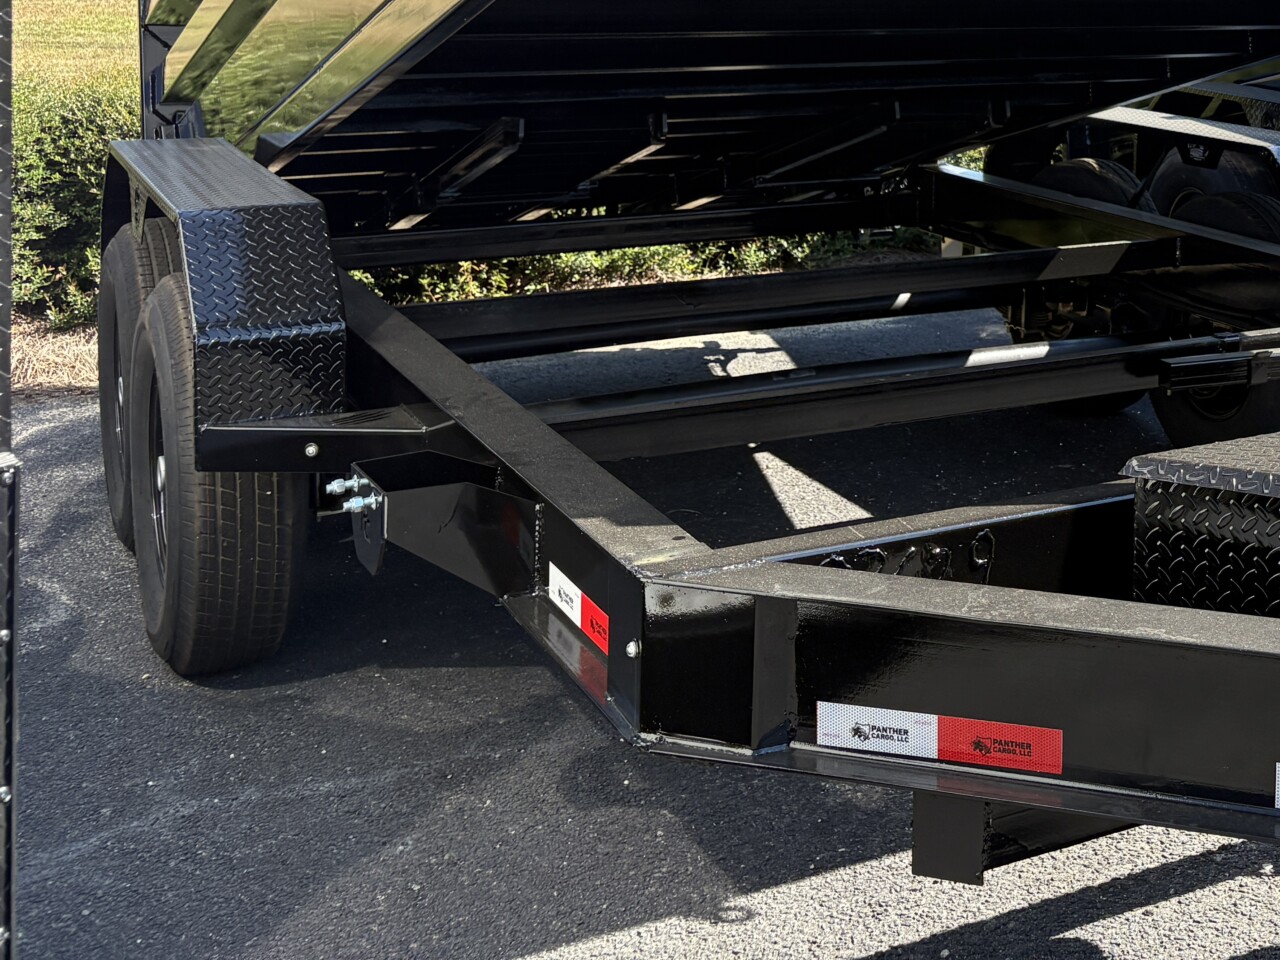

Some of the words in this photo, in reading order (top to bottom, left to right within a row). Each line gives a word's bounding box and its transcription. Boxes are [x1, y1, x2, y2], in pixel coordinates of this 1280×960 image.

[871, 725, 909, 736] PANTHER
[871, 732, 896, 741] CARGO,
[993, 738, 1032, 750] PANTHER
[992, 746, 1018, 756] CARGO,
